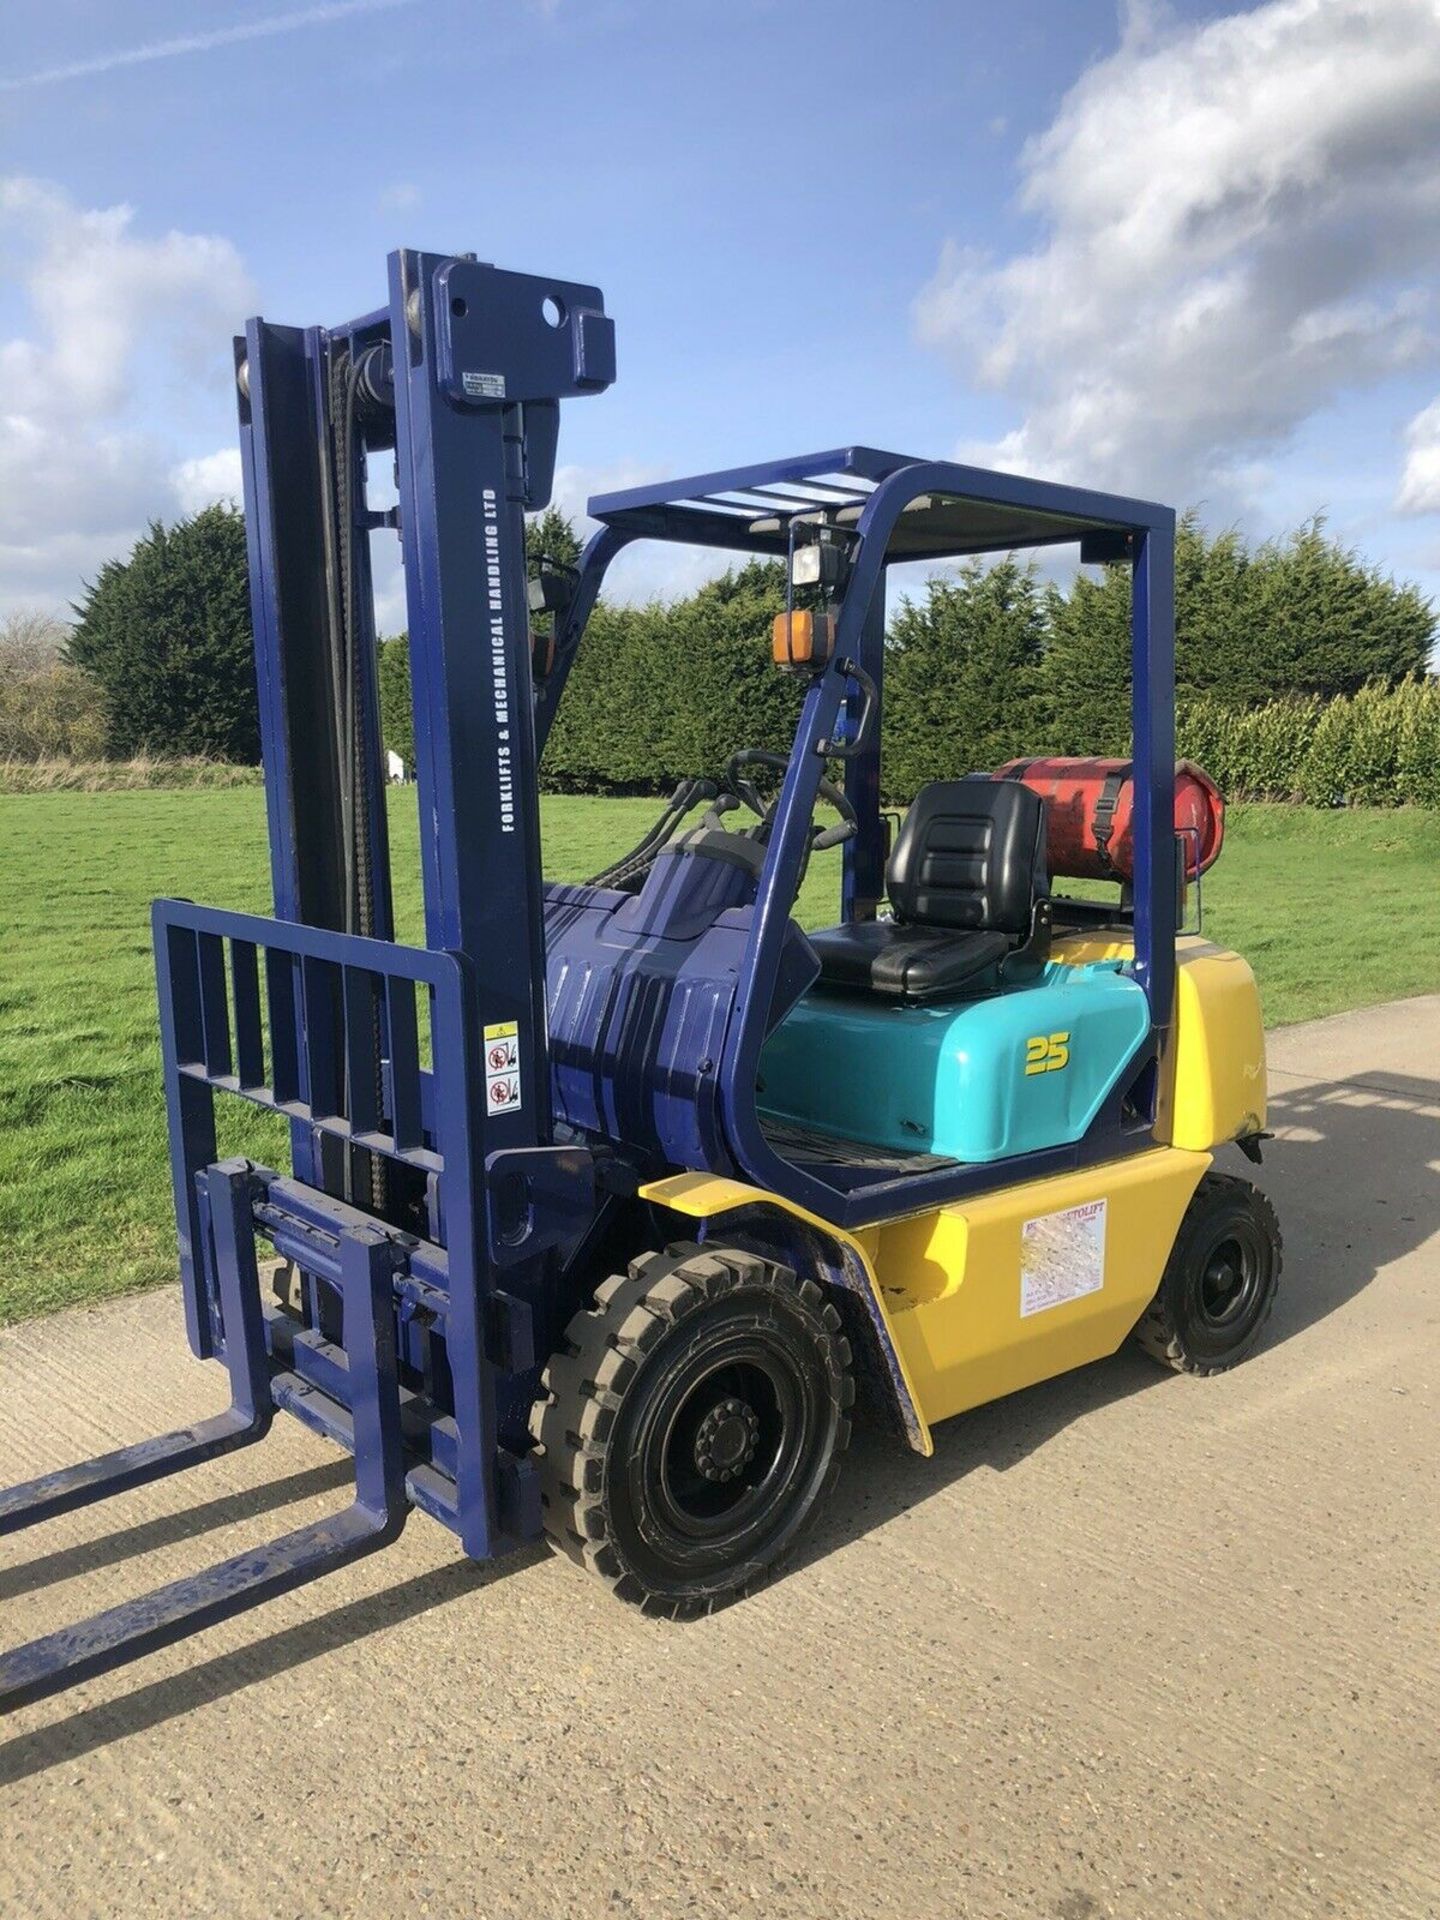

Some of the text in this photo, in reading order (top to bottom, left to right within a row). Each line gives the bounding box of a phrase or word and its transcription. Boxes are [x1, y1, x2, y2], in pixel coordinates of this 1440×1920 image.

[482, 489, 514, 832] FORKLIFTS & MECHANICAL HANDLING LTD
[1025, 1032, 1071, 1076] 25
